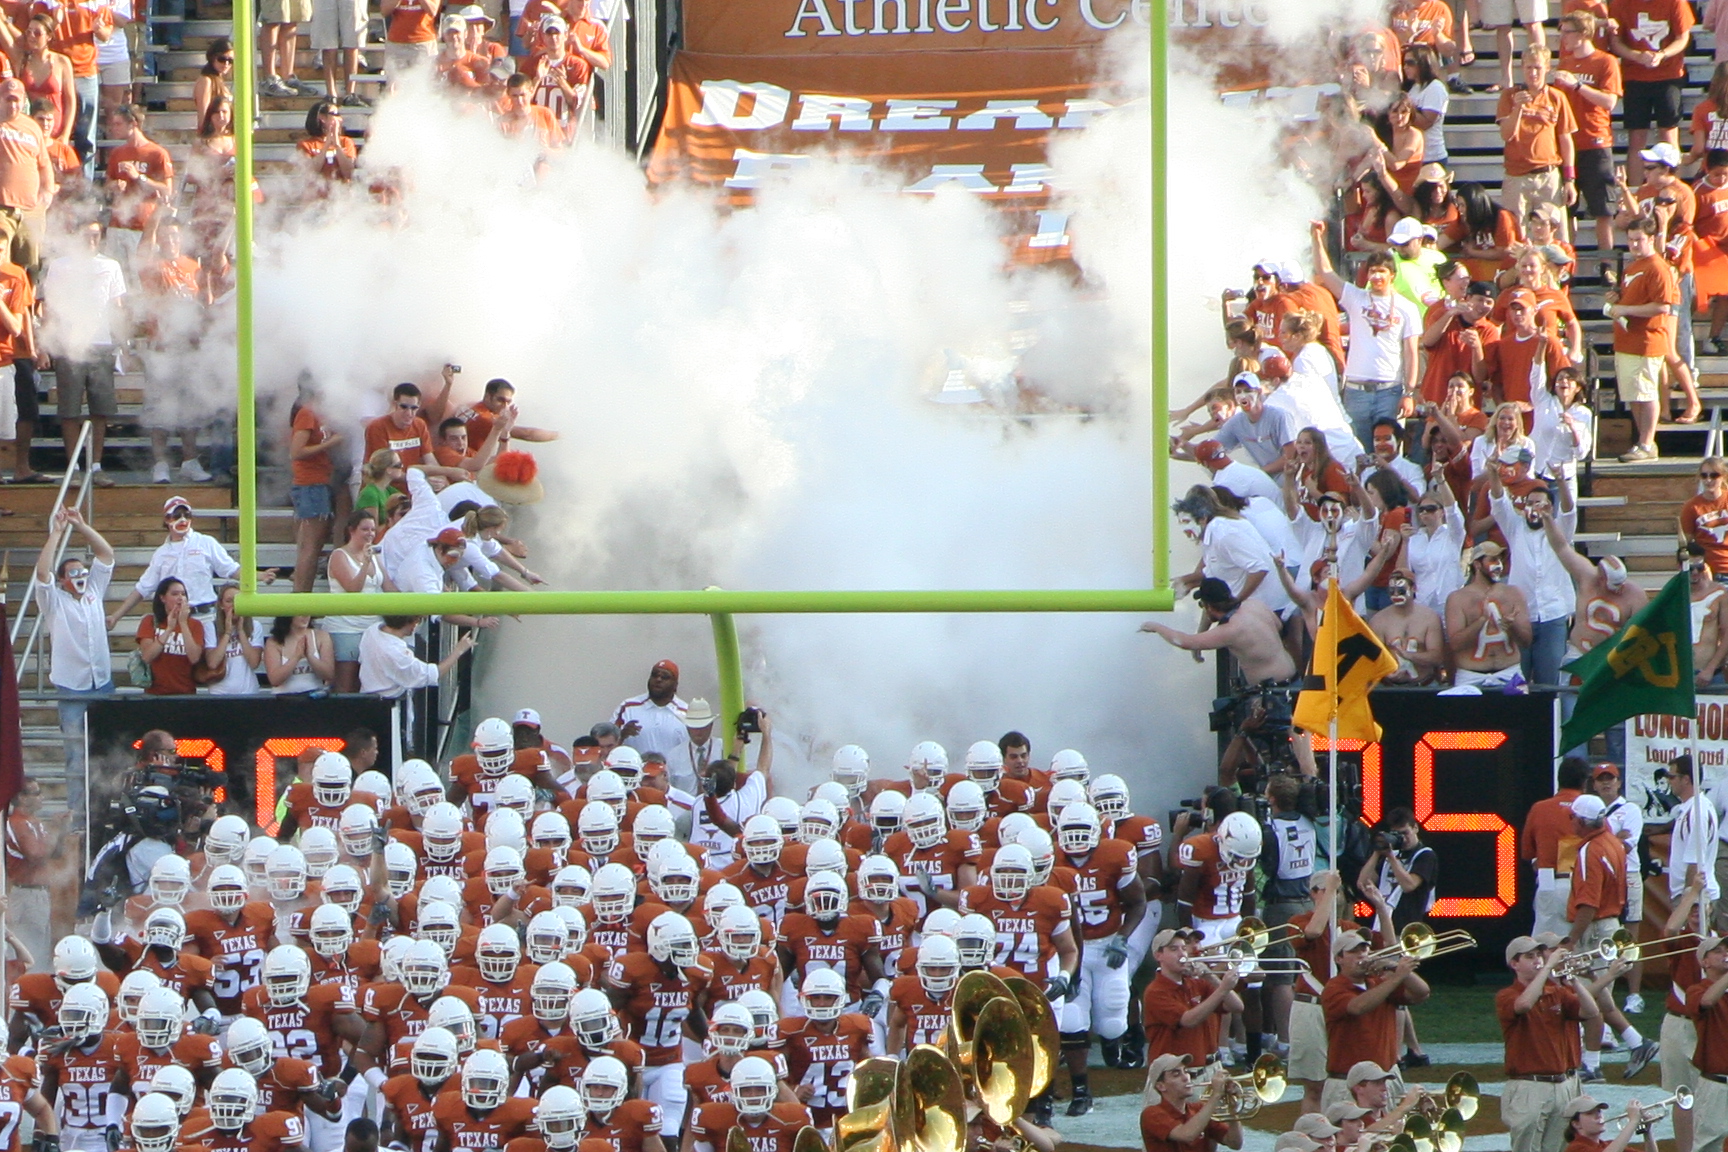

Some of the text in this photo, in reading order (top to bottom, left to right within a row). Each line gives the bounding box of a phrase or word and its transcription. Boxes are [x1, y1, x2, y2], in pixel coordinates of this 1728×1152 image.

[784, 0, 1271, 38] Athletic Cente
[1472, 600, 1517, 660] A
[311, 815, 339, 831] TEXA
[1143, 824, 1162, 842] 56
[425, 865, 464, 881] TEXAS
[750, 883, 790, 905] TEXAS
[997, 918, 1035, 934] TEXAS
[220, 934, 257, 953] TEXAS
[593, 931, 629, 947] TEXAS
[879, 933, 904, 951] EXAS
[808, 945, 846, 961] TEXAS
[995, 932, 1040, 974] 74
[213, 948, 267, 999] 53
[653, 991, 690, 1007] TEXAS
[267, 1010, 305, 1028] TEXAS
[809, 1045, 850, 1062] TEXAS
[67, 1066, 106, 1082] TEXAS
[798, 1060, 856, 1108] 43
[60, 1082, 110, 1127] 30
[457, 1131, 499, 1149] TEXAS
